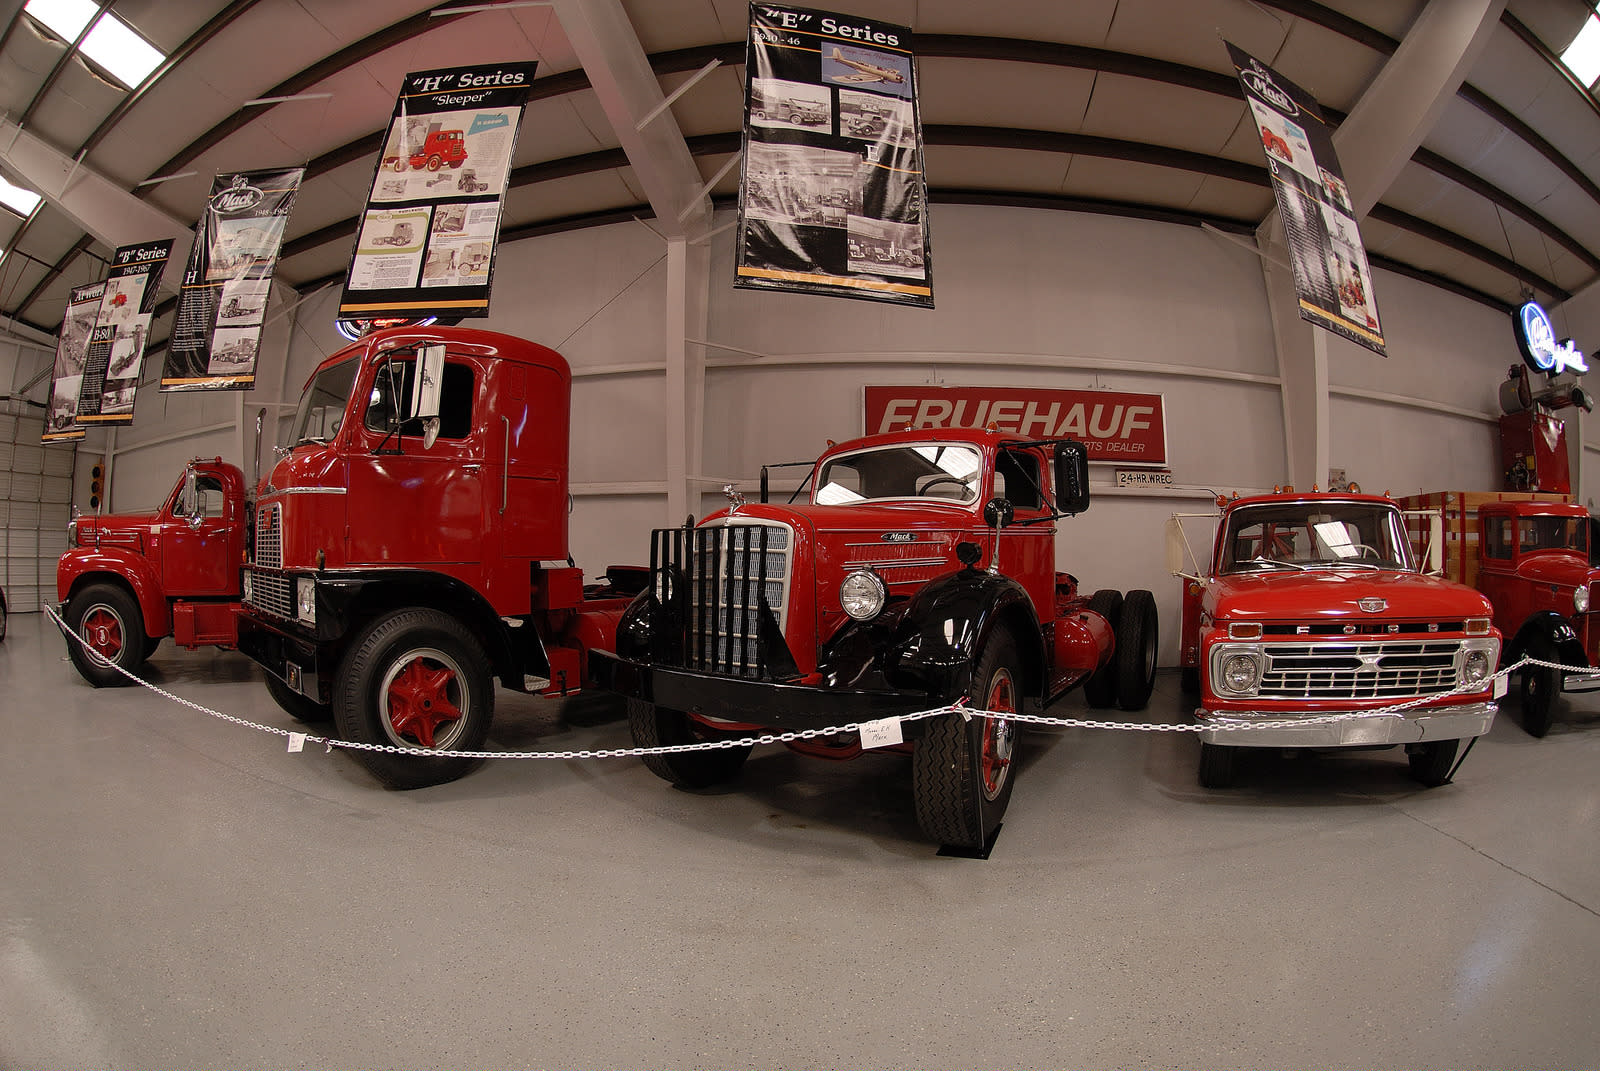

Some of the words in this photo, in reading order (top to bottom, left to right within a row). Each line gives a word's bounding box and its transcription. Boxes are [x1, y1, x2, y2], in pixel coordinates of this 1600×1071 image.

[766, 9, 813, 29] "E"
[821, 18, 900, 47] Series
[787, 36, 801, 46] 46
[412, 73, 455, 93] "H"
[457, 70, 525, 88] Series
[432, 90, 493, 106] "Sleeper"
[1253, 76, 1292, 111] Mack
[1269, 157, 1279, 175] B
[217, 190, 254, 209] Mack
[119, 249, 136, 264] "B"
[136, 246, 167, 261] Series
[185, 270, 199, 284] H
[878, 398, 1154, 440] FRUEHAUF
[1106, 441, 1146, 453] DEALER
[890, 532, 911, 541] Mack
[1296, 623, 1439, 635] FORD
